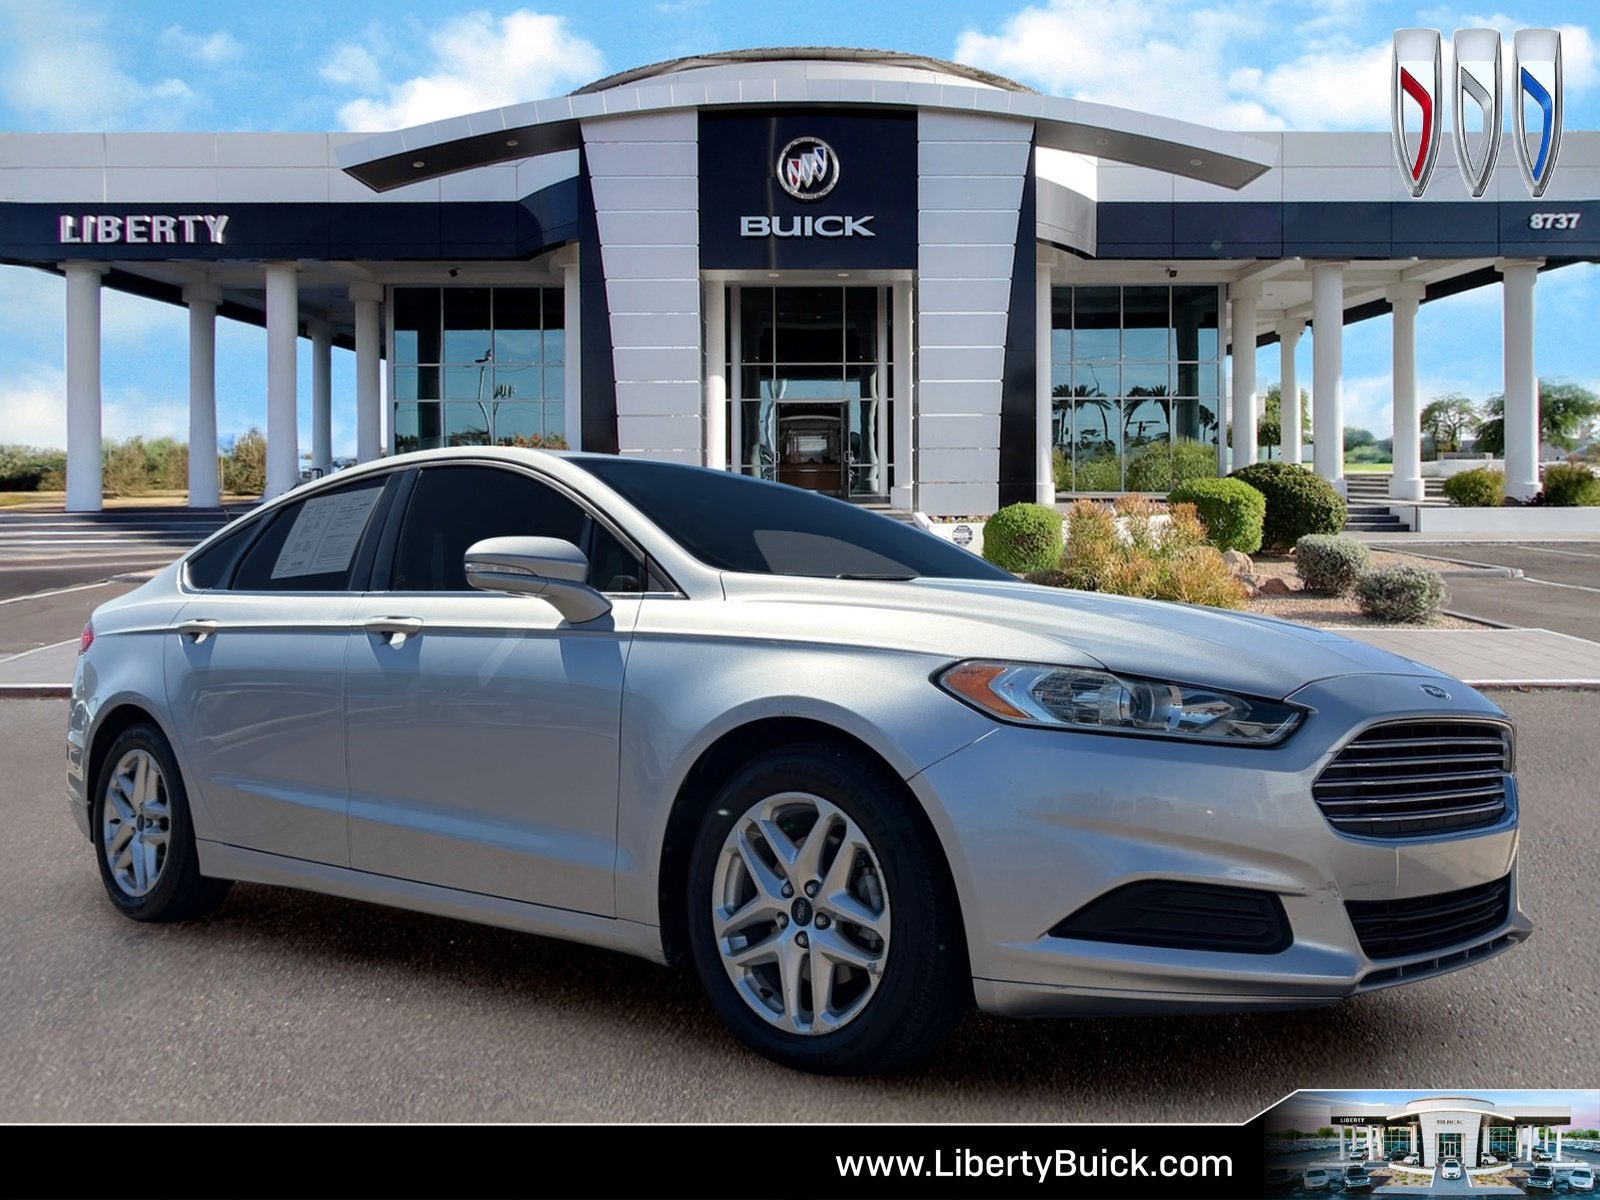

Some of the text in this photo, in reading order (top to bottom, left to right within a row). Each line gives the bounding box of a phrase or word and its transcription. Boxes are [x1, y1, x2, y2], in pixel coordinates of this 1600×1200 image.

[59, 215, 229, 244] LIBERTY
[740, 215, 876, 237] BUICK
[1529, 213, 1581, 230] 8737
